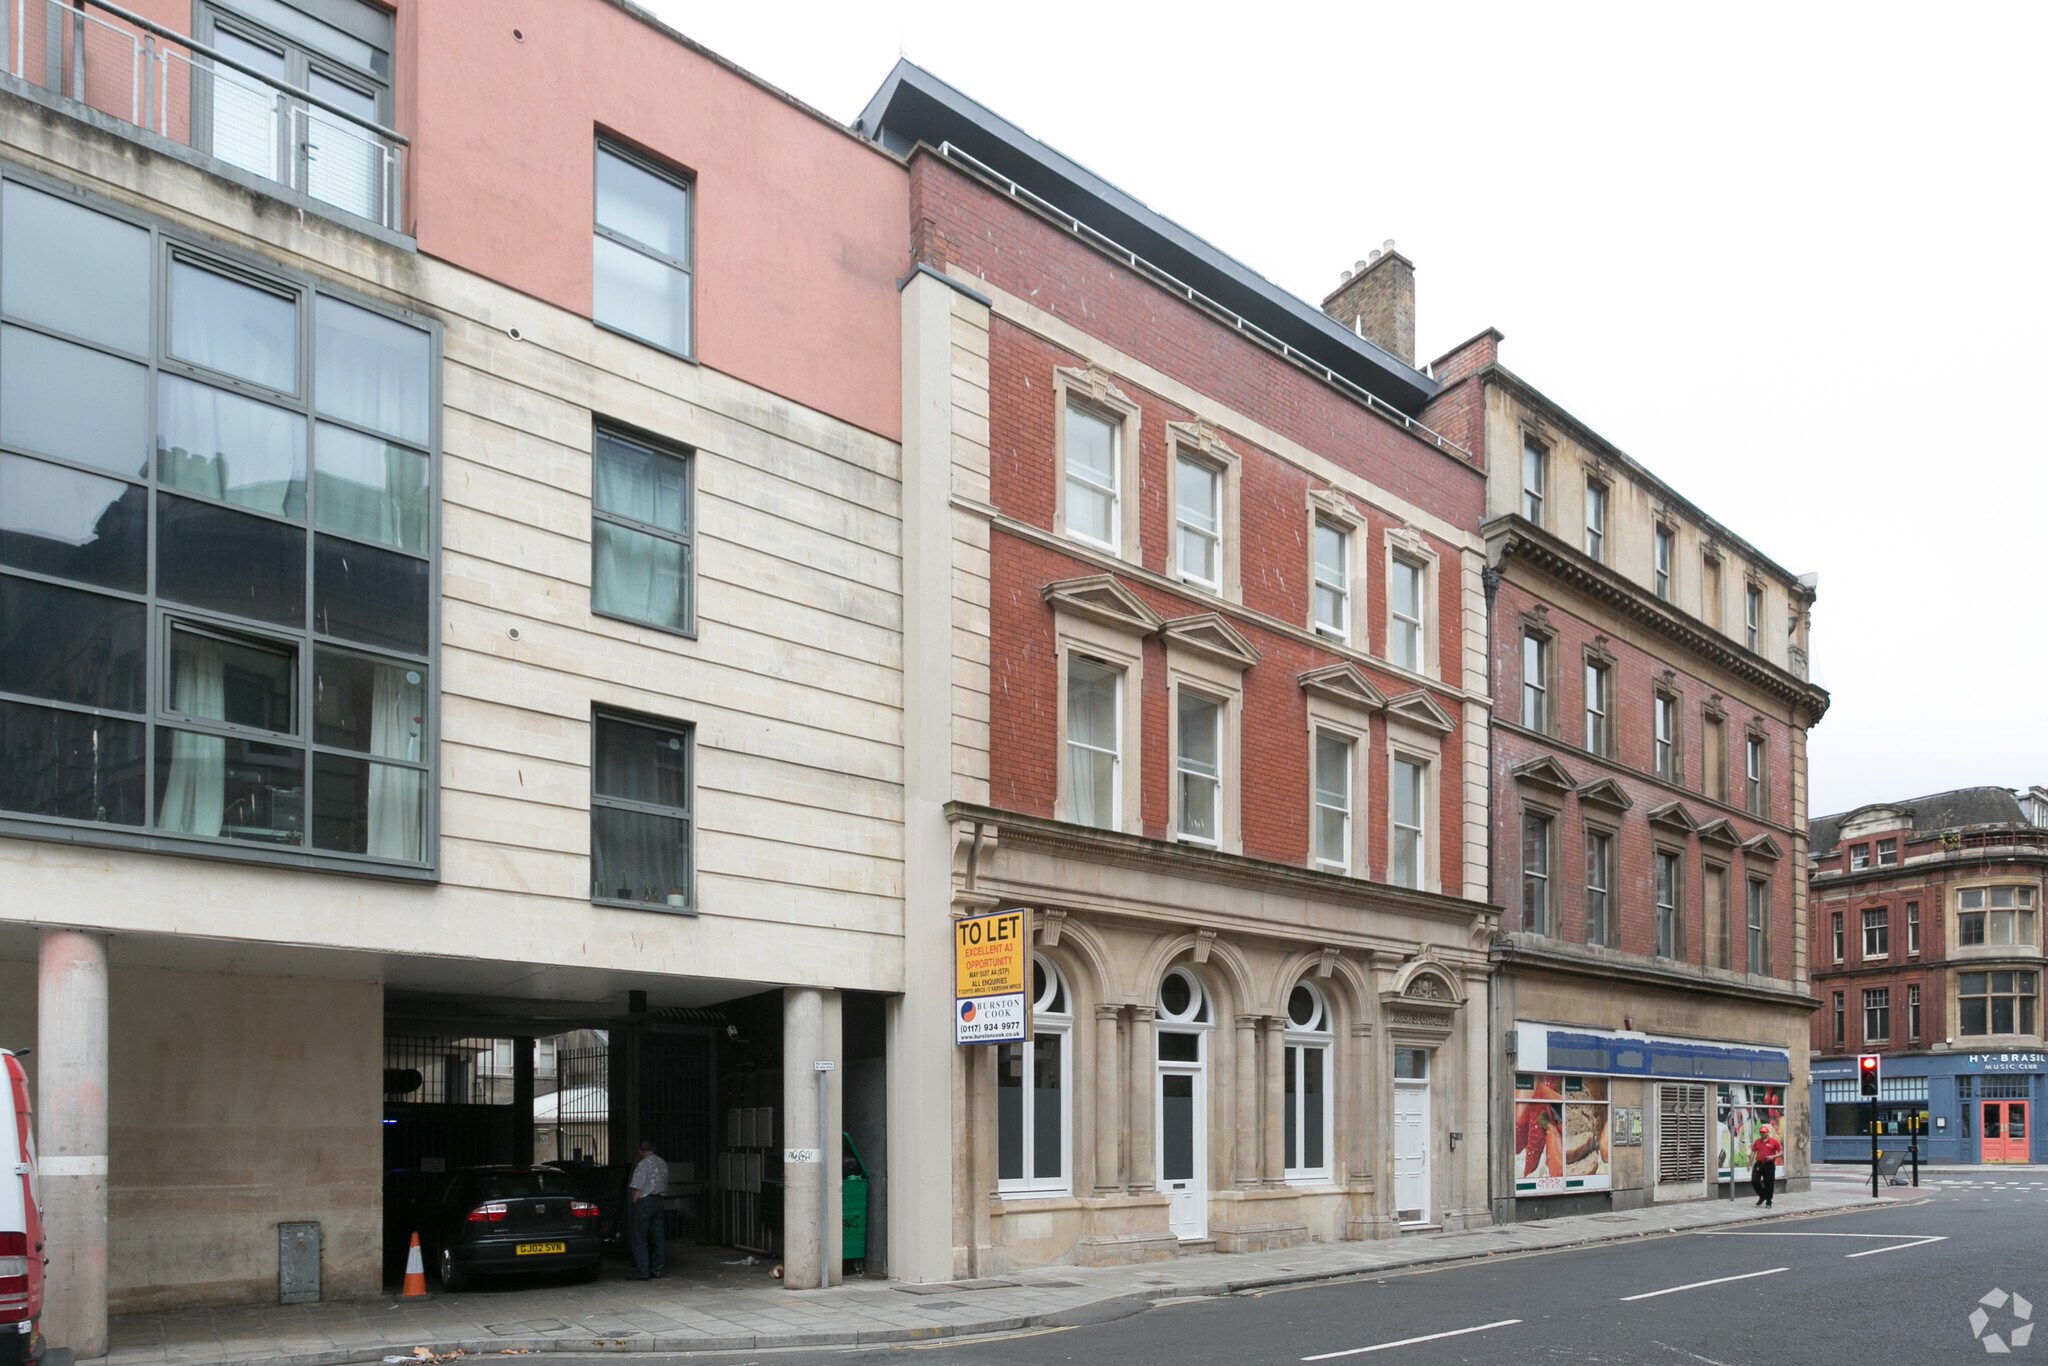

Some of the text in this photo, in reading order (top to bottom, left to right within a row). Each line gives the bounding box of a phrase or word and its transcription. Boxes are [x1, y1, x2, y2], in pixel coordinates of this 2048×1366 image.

[959, 915, 1020, 946] TO LET
[965, 943, 1013, 957] EXCELLENT A3
[966, 956, 1012, 970] OPPORTUNITY
[982, 977, 1008, 986] ENQUIRIES
[977, 999, 1020, 1010] BURSTON
[984, 1009, 1011, 1018] COOK
[960, 1021, 1020, 1033] (0117) 934 9977
[961, 1032, 1020, 1040] www.burstoncook.co.uk
[1969, 1054, 2046, 1063] HY-BRASIL
[520, 1243, 562, 1254] GJ02 SVN
